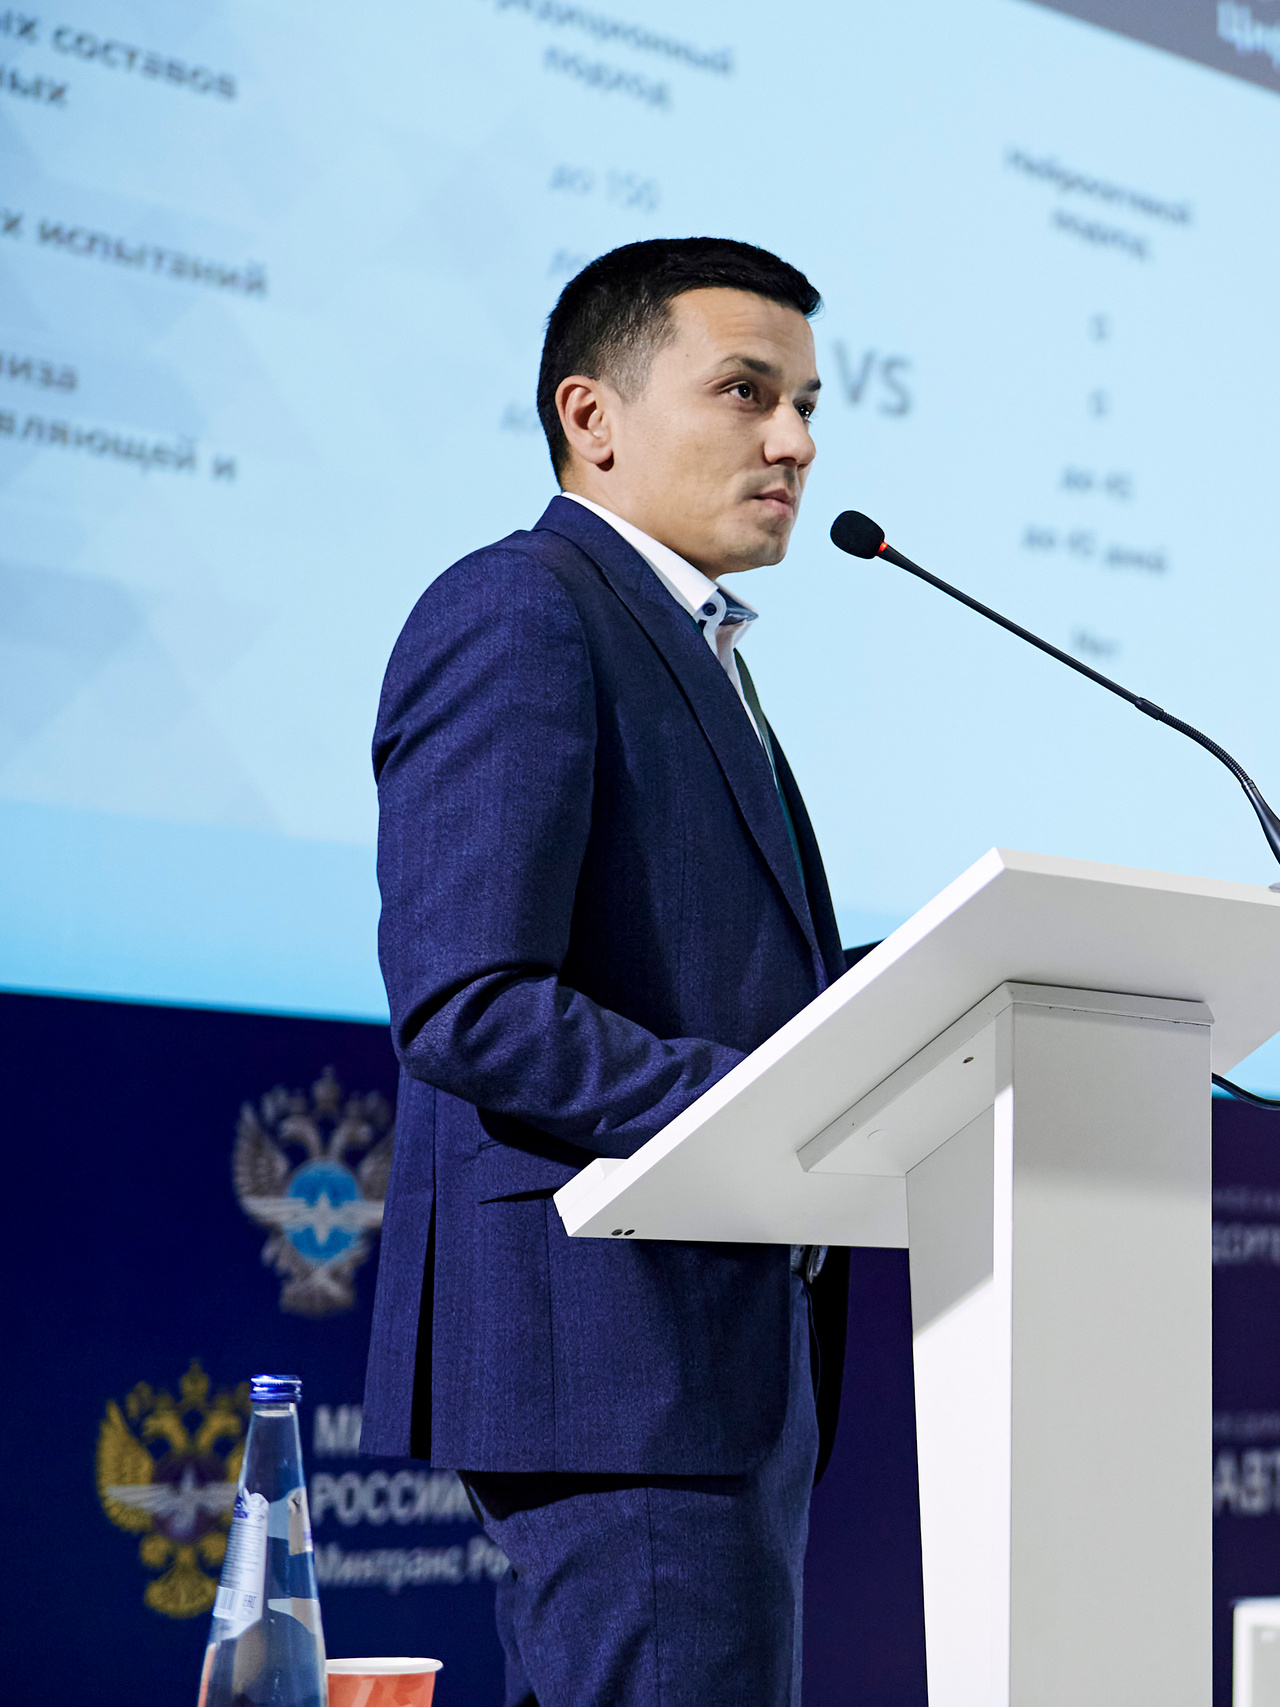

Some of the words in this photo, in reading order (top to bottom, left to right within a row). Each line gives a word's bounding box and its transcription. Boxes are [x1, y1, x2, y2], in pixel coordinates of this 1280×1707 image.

[0, 64, 67, 107] ых
[52, 25, 238, 102] составов
[37, 218, 267, 301] испытаний
[0, 352, 78, 393] иза
[831, 338, 914, 418] VS
